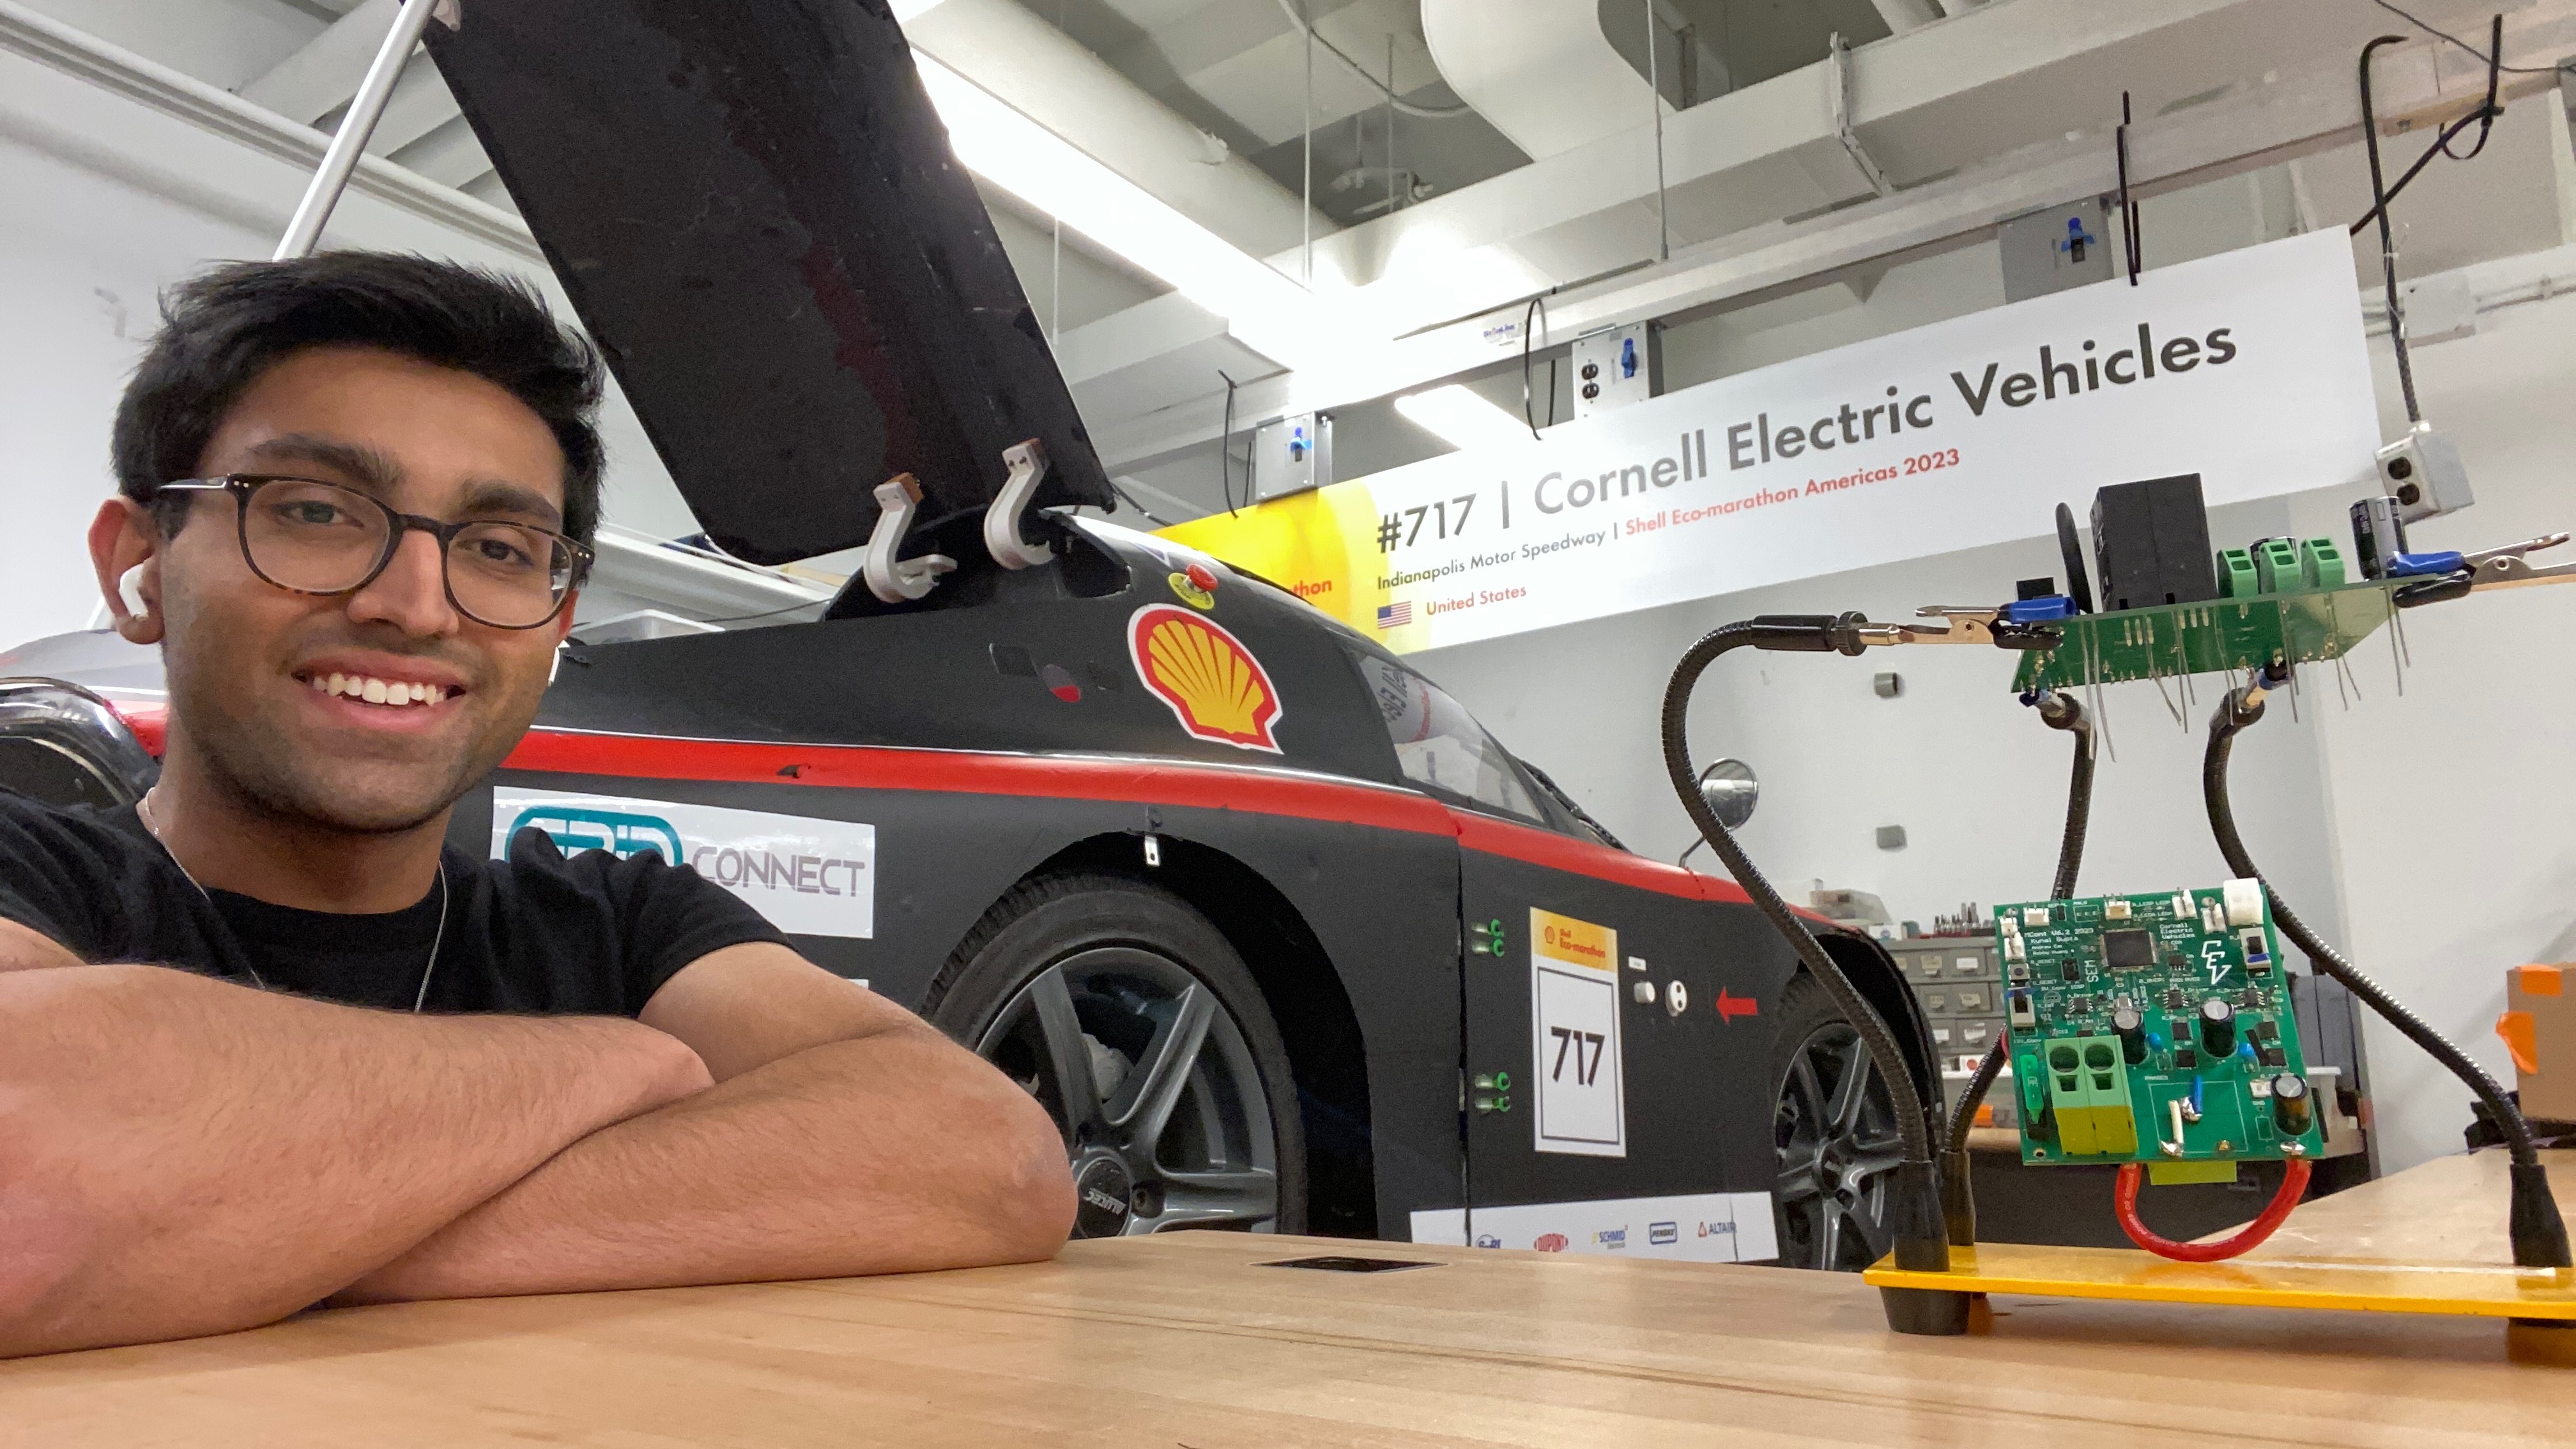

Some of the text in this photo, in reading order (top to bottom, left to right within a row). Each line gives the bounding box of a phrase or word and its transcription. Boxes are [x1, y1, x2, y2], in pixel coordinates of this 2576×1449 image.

[1377, 493, 1476, 553] #717
[1534, 428, 1707, 514] Cornell
[1728, 386, 1933, 470] Electric
[1950, 322, 2237, 417] Vehicles
[1377, 559, 1465, 590] Indianapolis
[1470, 551, 1516, 569] Motor
[1522, 531, 1606, 560] Speedway
[1626, 511, 1666, 535] Shell
[1672, 488, 1798, 525] Eco-marathon
[1805, 466, 1897, 496] Americas
[1904, 448, 1959, 475] 2023
[1426, 587, 1526, 615] United States
[693, 847, 866, 897] CONNECT
[1560, 937, 1606, 958] Eco-marathon
[2084, 960, 2099, 983] SEM
[1551, 1026, 1605, 1087] 717
